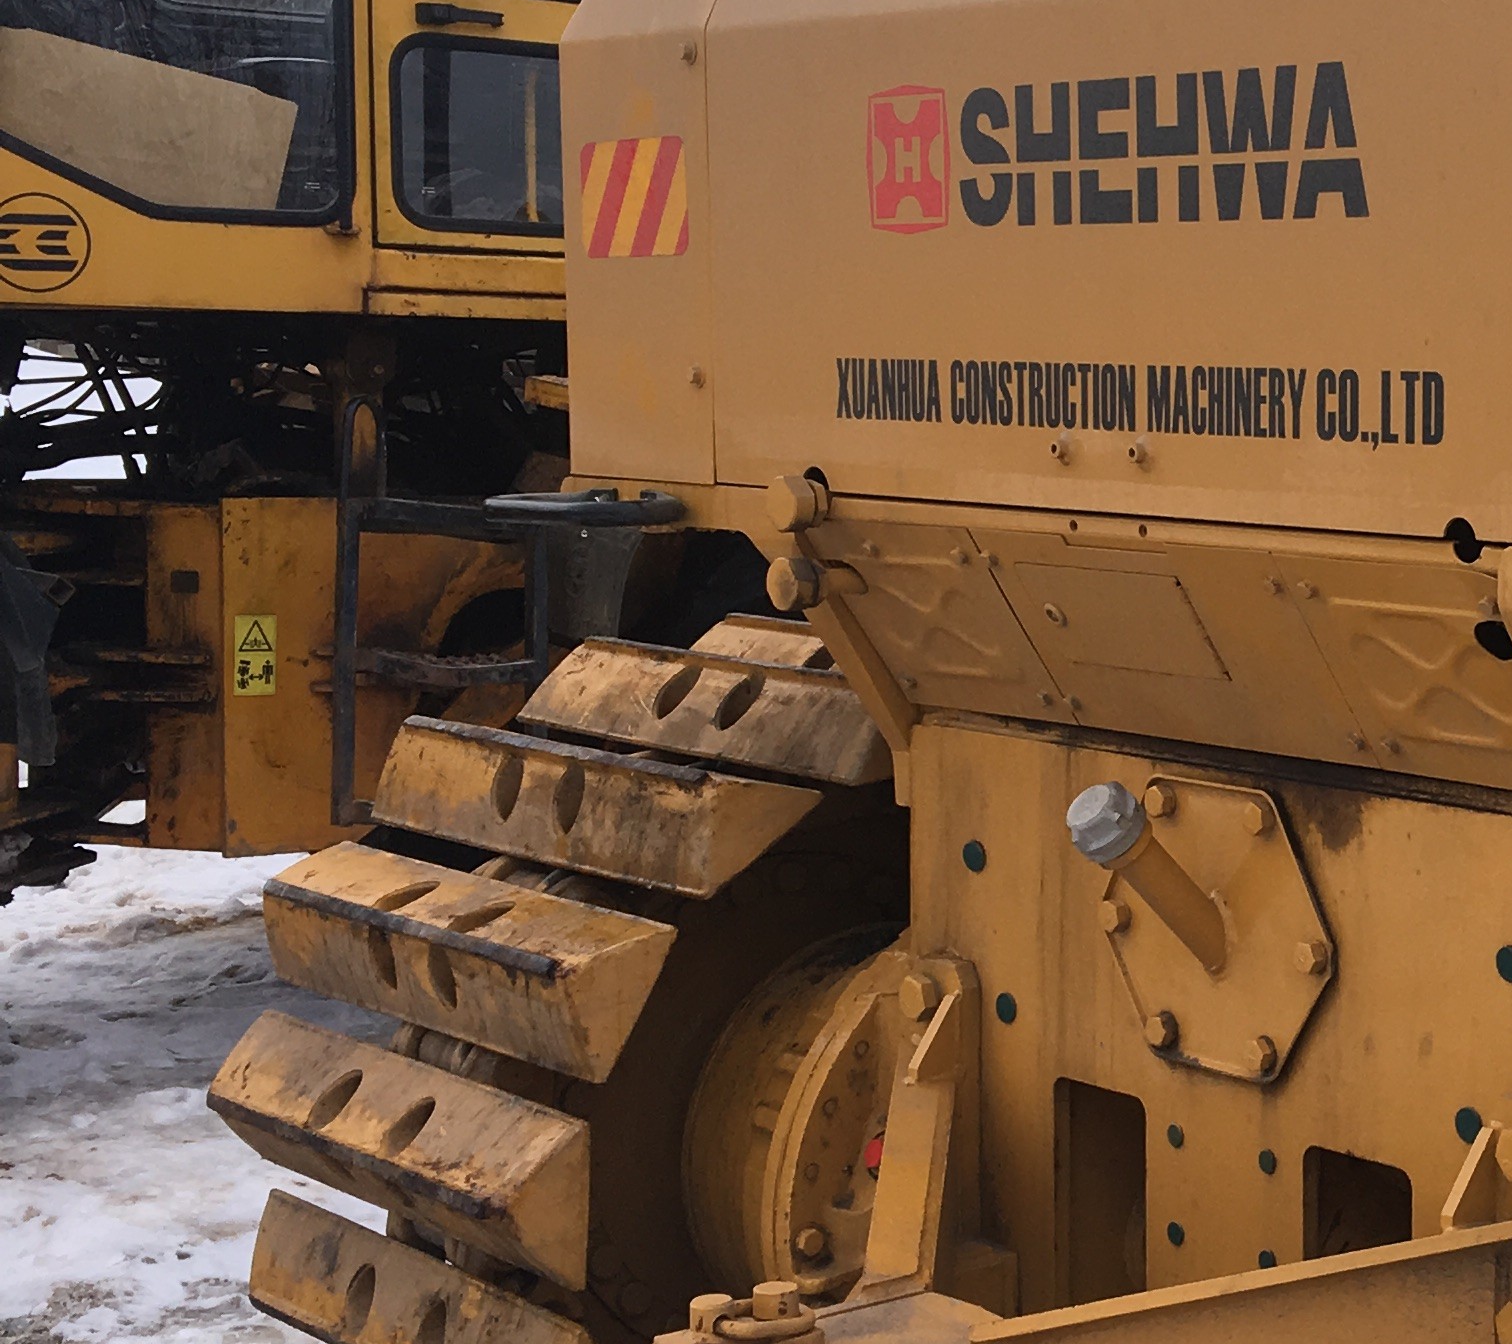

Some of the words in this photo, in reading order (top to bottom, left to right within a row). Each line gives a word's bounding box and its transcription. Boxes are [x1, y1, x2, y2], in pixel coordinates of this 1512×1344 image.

[959, 61, 1370, 227] SHEHWA
[836, 358, 942, 423] XUANHUA
[950, 359, 1136, 432] CONSTRUCTION
[1147, 365, 1307, 440] MACHINERY
[1316, 368, 1445, 451] CO.,LTD
